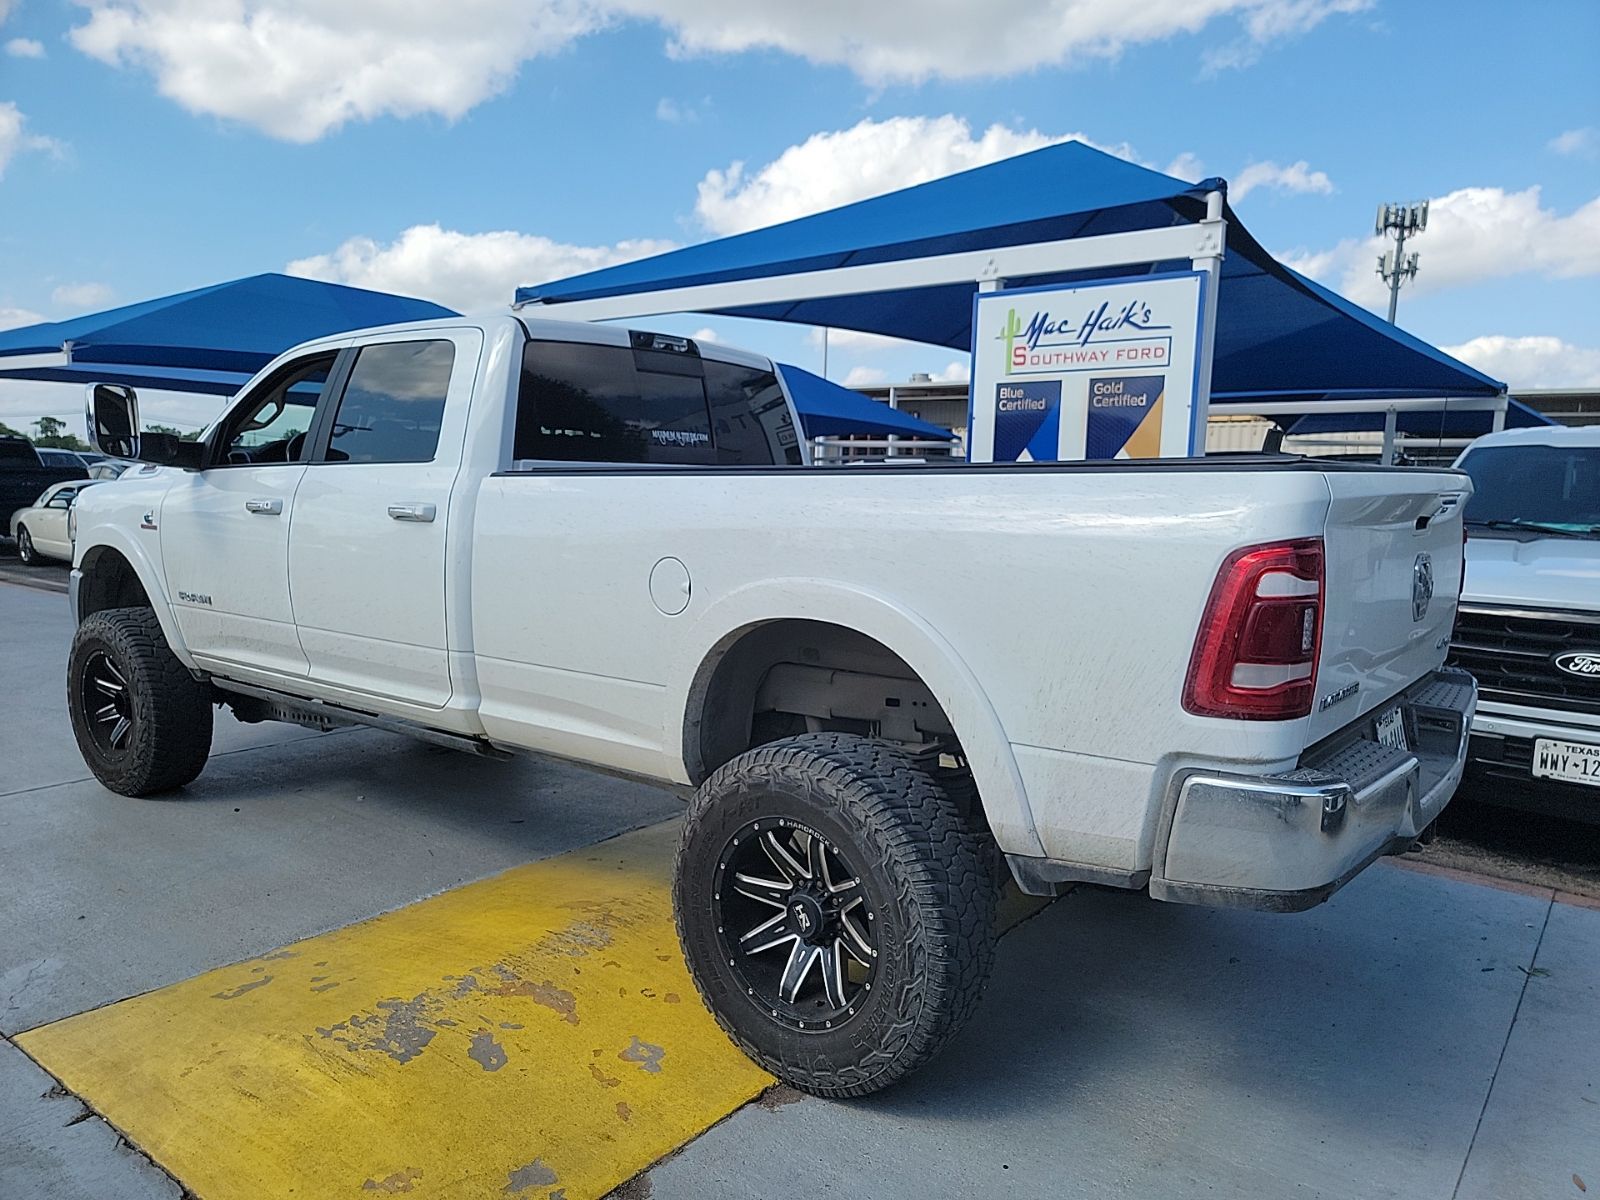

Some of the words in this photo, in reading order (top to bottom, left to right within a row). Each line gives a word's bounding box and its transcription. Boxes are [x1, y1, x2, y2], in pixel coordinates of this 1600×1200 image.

[1022, 311, 1077, 351] Mac
[1077, 300, 1156, 347] Haik's
[1012, 346, 1110, 367] SOUTHWAY
[1116, 347, 1165, 361] FORD
[1000, 387, 1024, 399] Blue
[1093, 381, 1124, 395] Gold
[999, 398, 1046, 411] Certified
[1093, 393, 1147, 408] Certified
[1569, 656, 1600, 673] For
[1564, 745, 1600, 757] TEXAS
